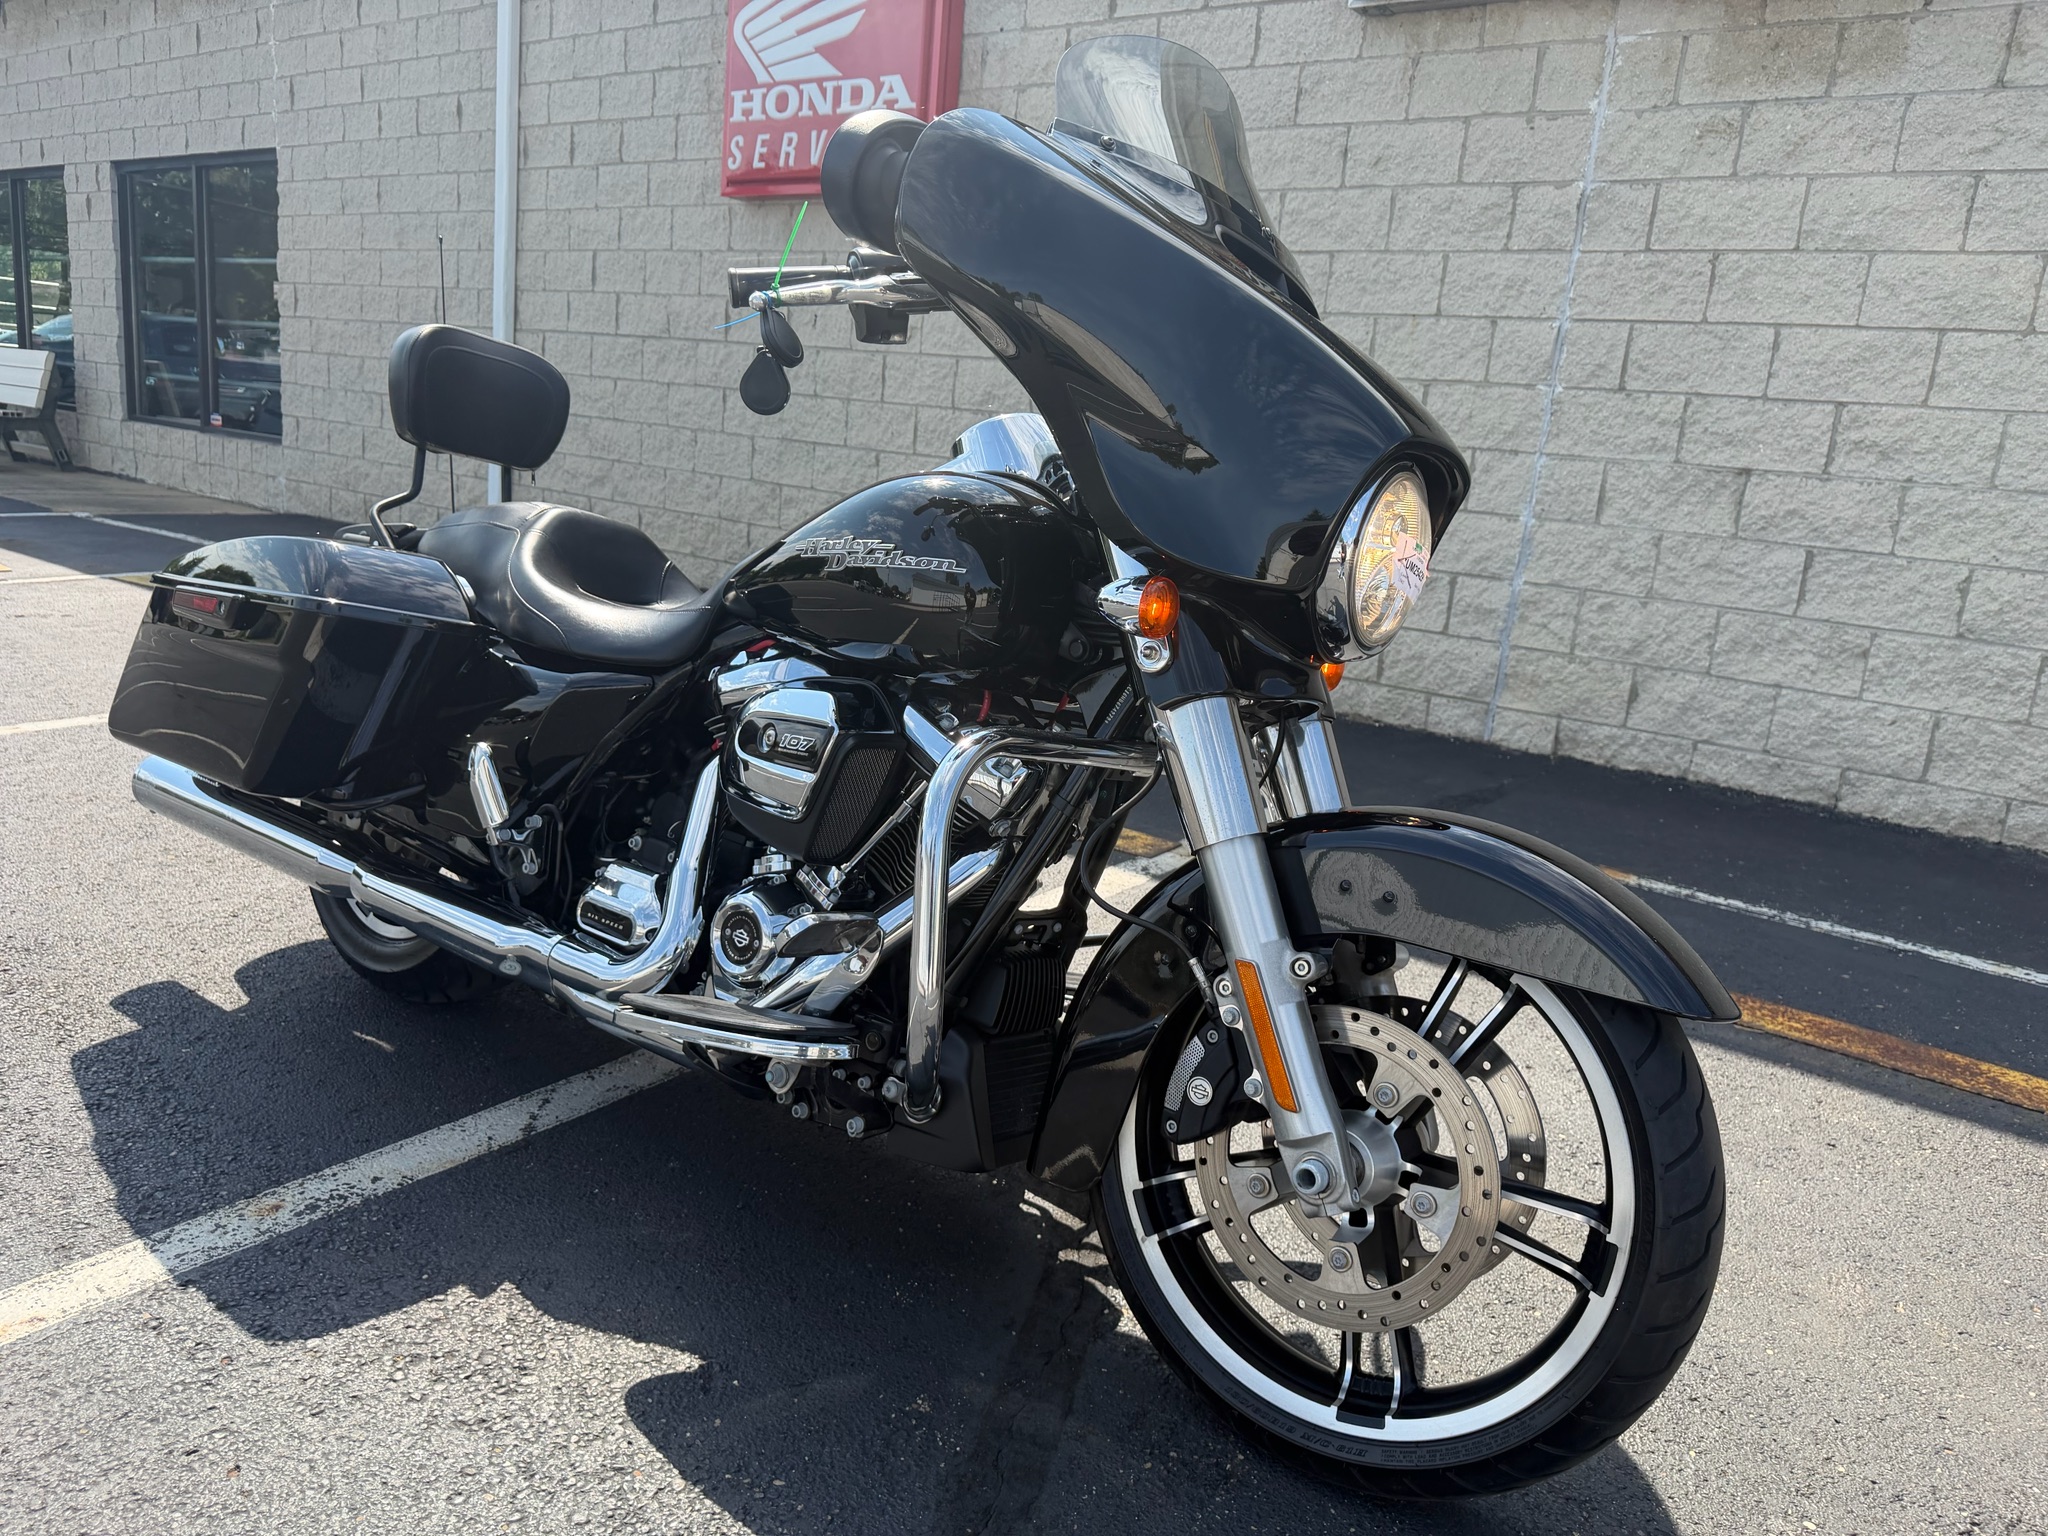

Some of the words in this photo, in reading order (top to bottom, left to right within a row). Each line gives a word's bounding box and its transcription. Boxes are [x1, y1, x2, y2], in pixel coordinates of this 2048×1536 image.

[730, 74, 916, 122] HONDA
[796, 535, 896, 558] Harley
[824, 550, 967, 573] Davidson
[779, 733, 816, 751] 107
